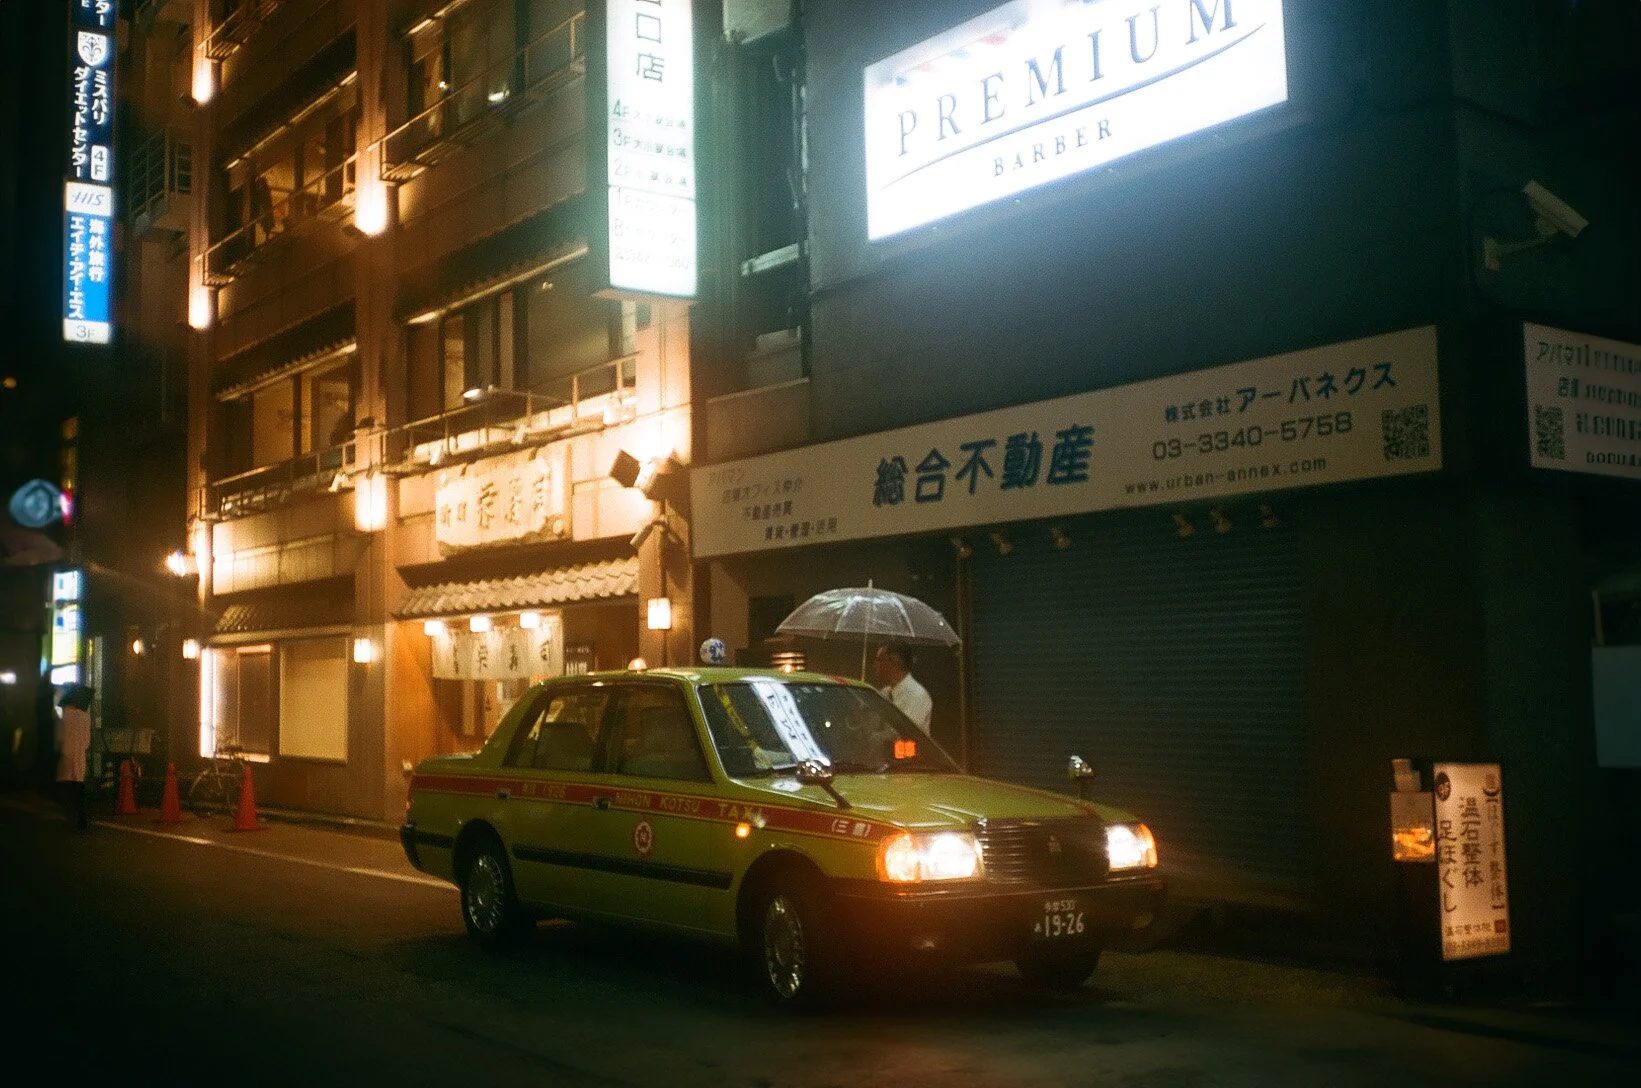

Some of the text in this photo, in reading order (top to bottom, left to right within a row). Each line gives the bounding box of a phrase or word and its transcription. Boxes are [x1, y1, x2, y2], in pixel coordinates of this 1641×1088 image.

[635, 0, 665, 82] 口店
[897, 0, 1238, 157] PREMIUM
[72, 66, 89, 178] ダイエットセンター
[994, 119, 1113, 177] BARBER
[1152, 411, 1352, 461] 03-3340-5758
[872, 424, 1096, 508] 総合不動産
[1124, 456, 1327, 495] www.urban-annex.com
[659, 795, 701, 813] KOTSU
[1045, 912, 1085, 938] 19-26
